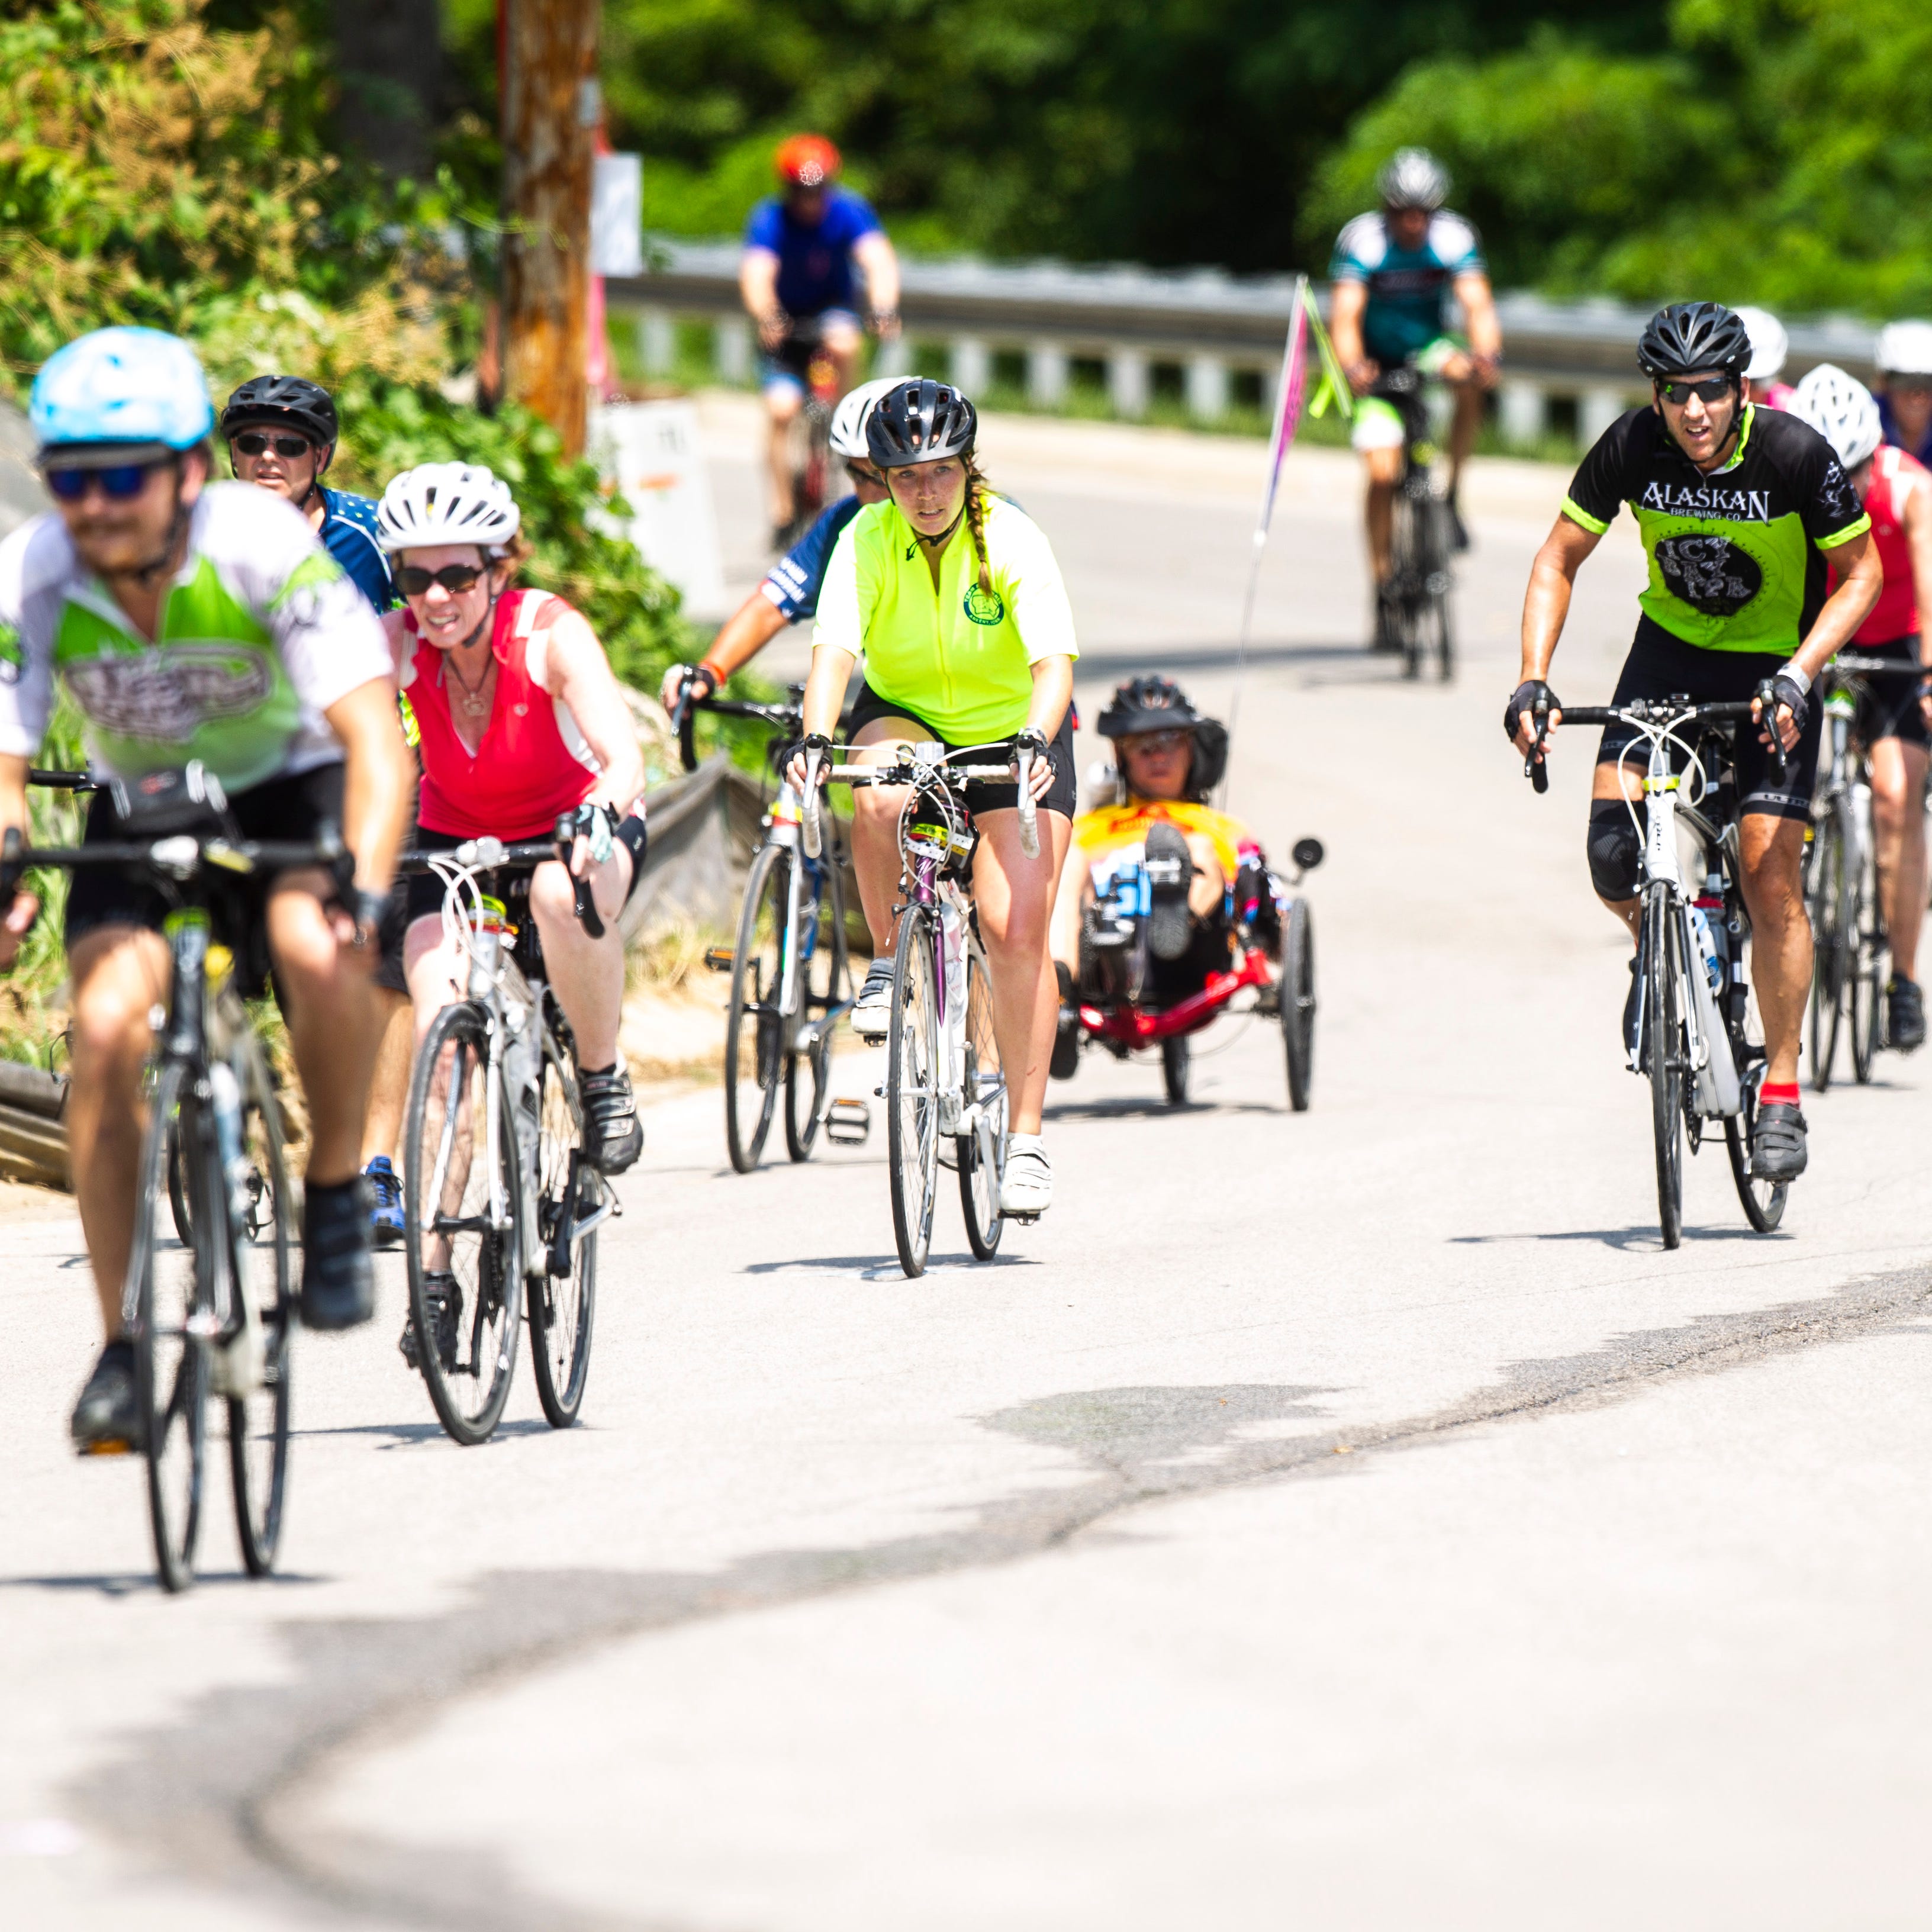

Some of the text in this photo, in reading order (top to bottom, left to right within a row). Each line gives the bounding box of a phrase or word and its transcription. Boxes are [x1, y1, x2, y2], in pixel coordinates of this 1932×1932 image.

[1640, 482, 1771, 526] ALASKAN
[1670, 507, 1721, 520] BREWING
[1665, 536, 1731, 561] ICY
